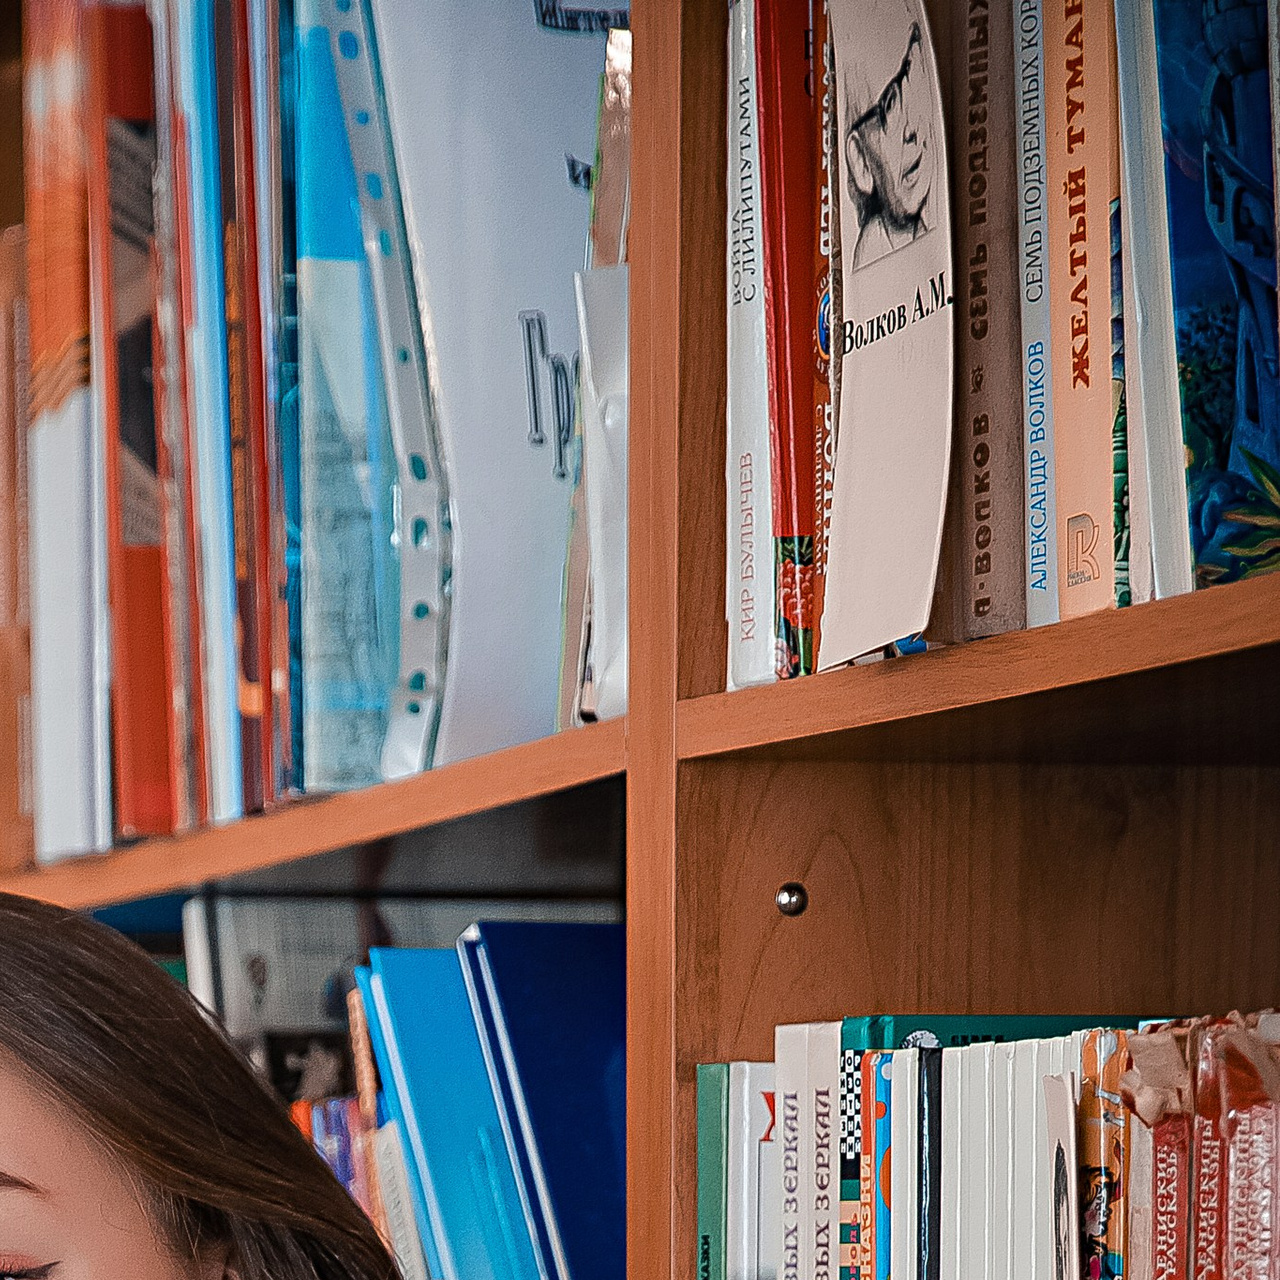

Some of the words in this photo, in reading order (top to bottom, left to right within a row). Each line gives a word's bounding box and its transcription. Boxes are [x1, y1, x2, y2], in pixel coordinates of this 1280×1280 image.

[739, 76, 755, 275] ЛИЛИПУТАМИ
[1021, 53, 1044, 226] ПОДЗЕМНЫХ
[742, 283, 755, 301] С
[841, 304, 907, 355] Волков
[911, 271, 954, 323] А.М.
[968, 243, 988, 341] СЕМЬ
[1024, 229, 1043, 303] СЕМЬ
[1062, 166, 1090, 389] ЖЕЛТЫЙ
[1027, 341, 1047, 444] ВОЛКОВ
[740, 452, 754, 580] БУЛЫЧЕВ
[1028, 449, 1048, 591] АЛЕКСАНДР
[741, 588, 756, 642] КИР
[1206, 1138, 1221, 1272] РАССКАЗЫ
